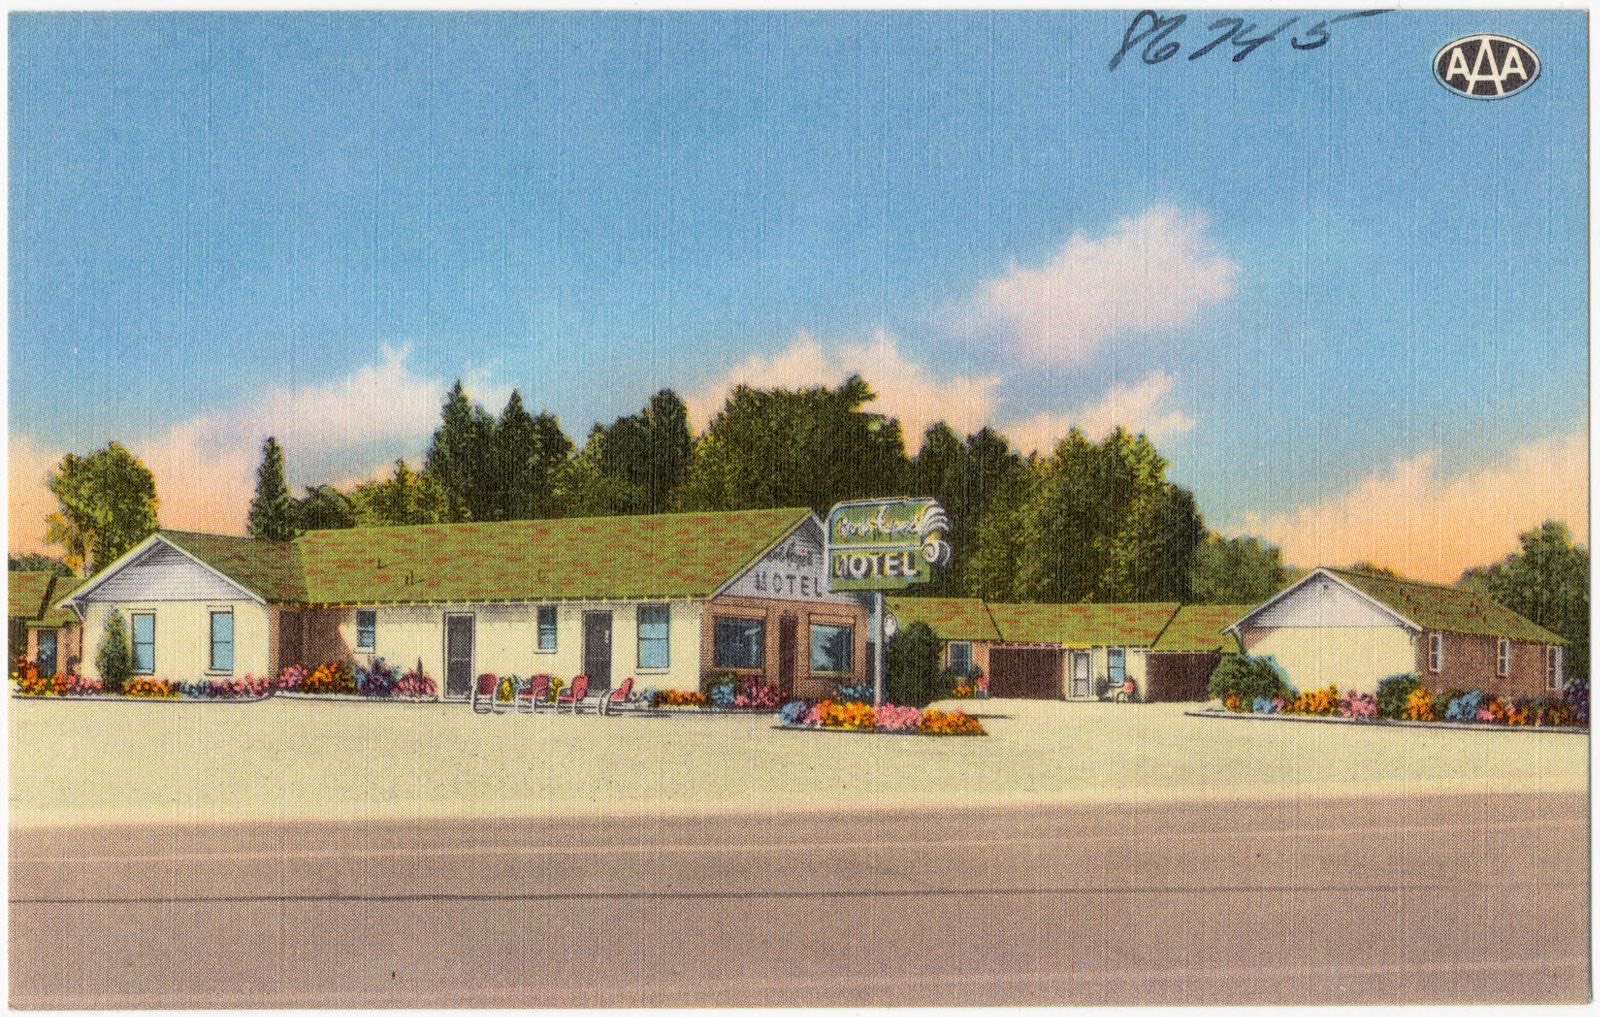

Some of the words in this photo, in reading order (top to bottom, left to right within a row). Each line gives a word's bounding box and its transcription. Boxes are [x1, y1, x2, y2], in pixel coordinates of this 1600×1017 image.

[1445, 38, 1528, 97] AAA
[835, 551, 921, 581] MOTEL
[754, 570, 823, 598] MOTEL
